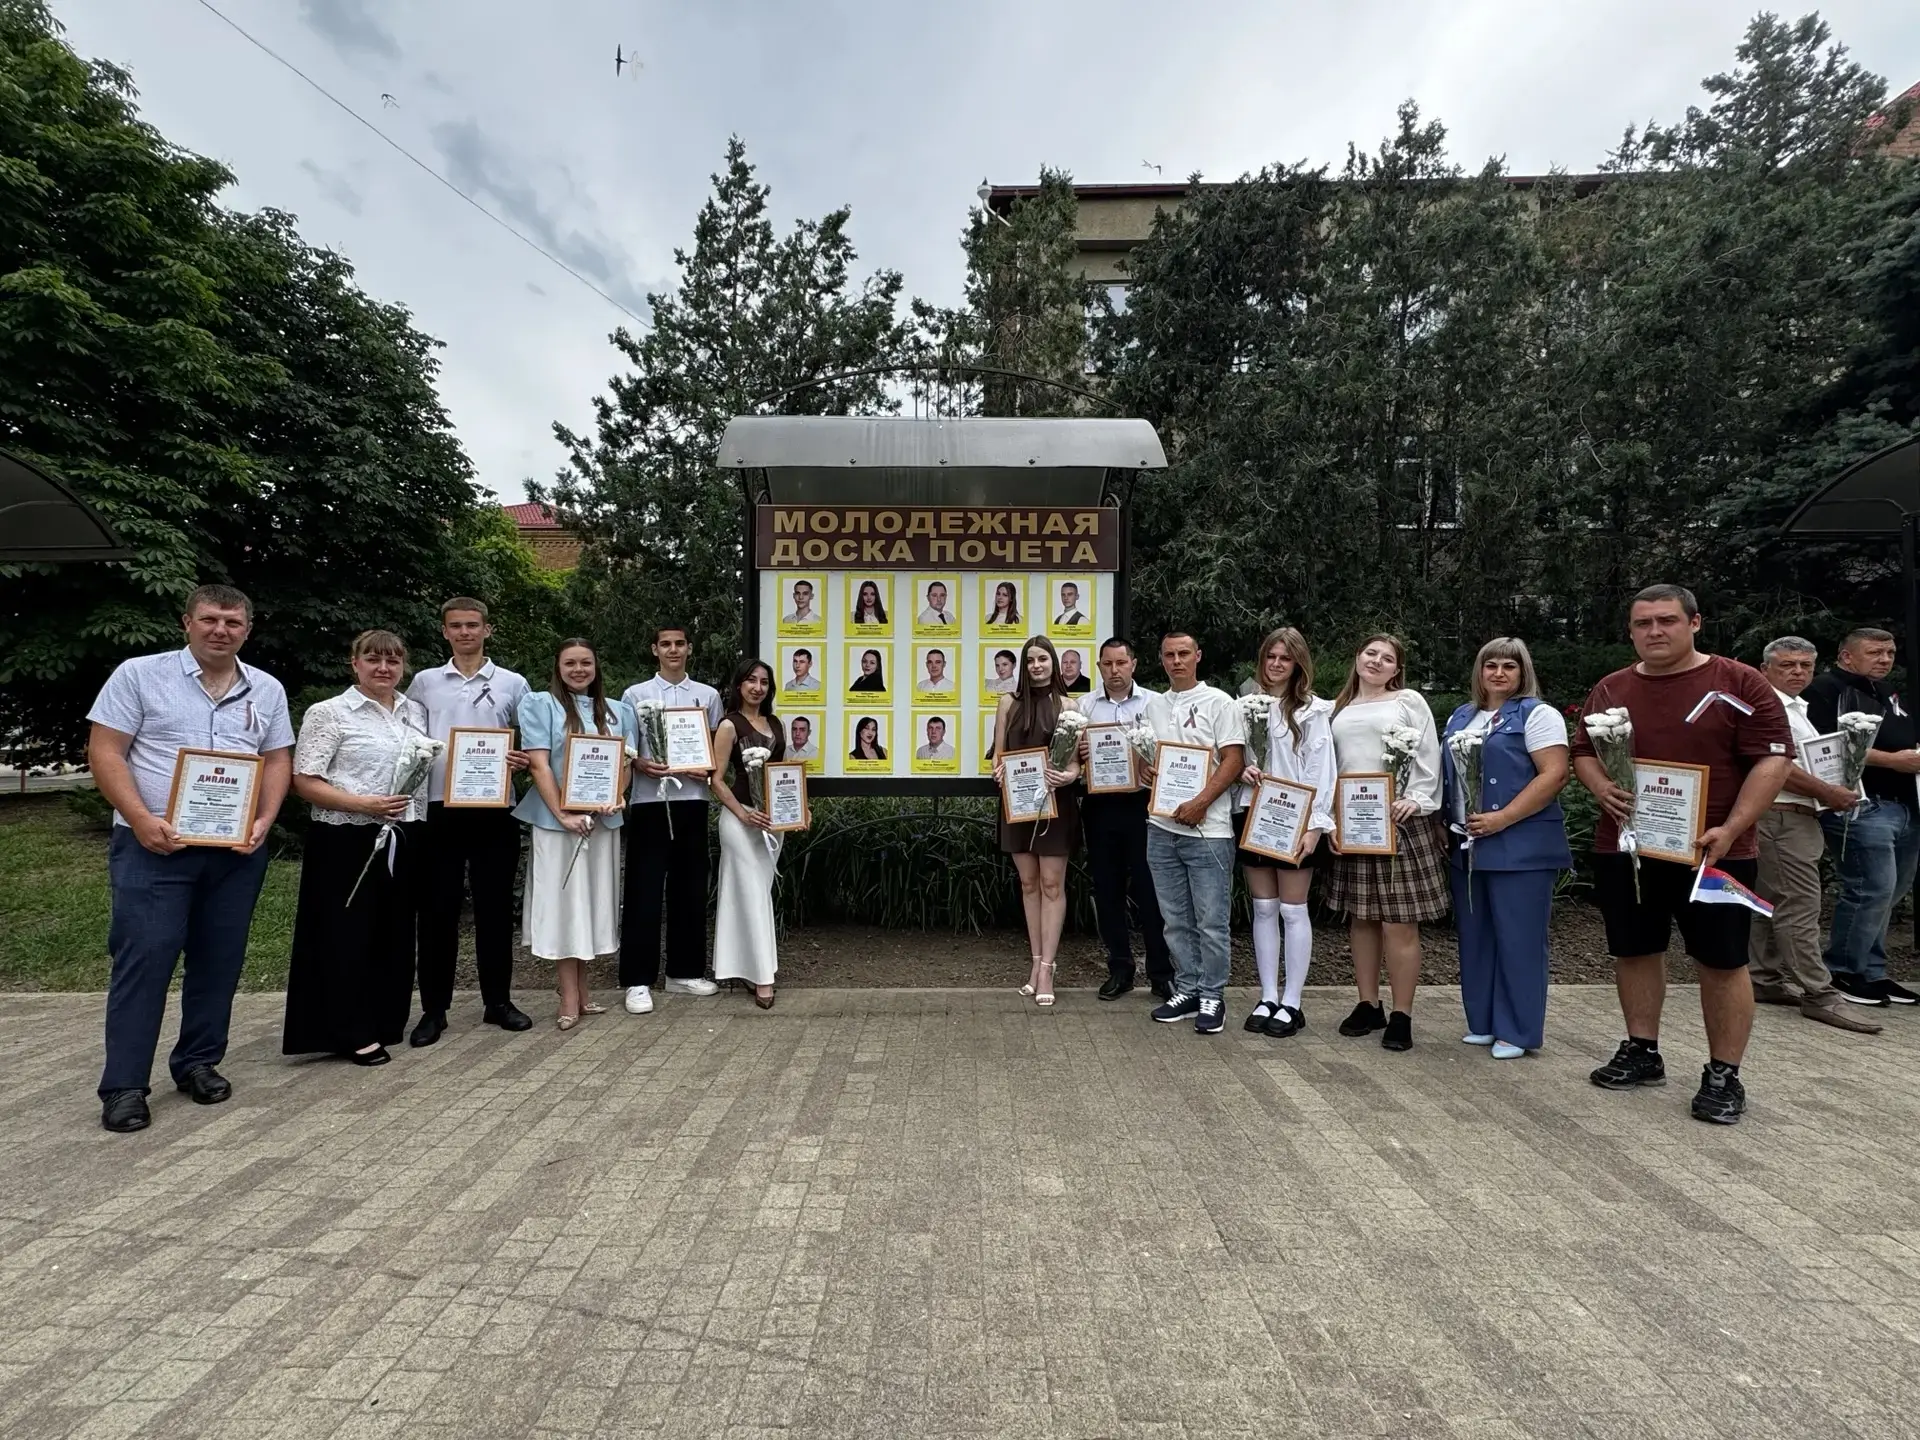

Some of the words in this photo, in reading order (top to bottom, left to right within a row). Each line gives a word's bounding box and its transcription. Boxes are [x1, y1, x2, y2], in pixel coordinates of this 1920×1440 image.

[773, 511, 1099, 538] МОЛОДЕЖНАЯ
[770, 539, 915, 566] ДОСКА
[929, 540, 1098, 564] ПОЧЕТА
[1097, 740, 1121, 748] ДИПЛОМ
[465, 747, 496, 755] ДИПЛОМ
[580, 753, 609, 761] ДИПЛОМ
[1013, 766, 1037, 776] ДИПЛОМ
[1169, 761, 1197, 771] ДИПЛОМ
[197, 774, 238, 785] ДИПЛОМ
[1643, 784, 1683, 797] ДИПЛОМ
[1350, 793, 1378, 801] ДИПЛОМ
[1267, 796, 1296, 809] ДИПЛОМ
